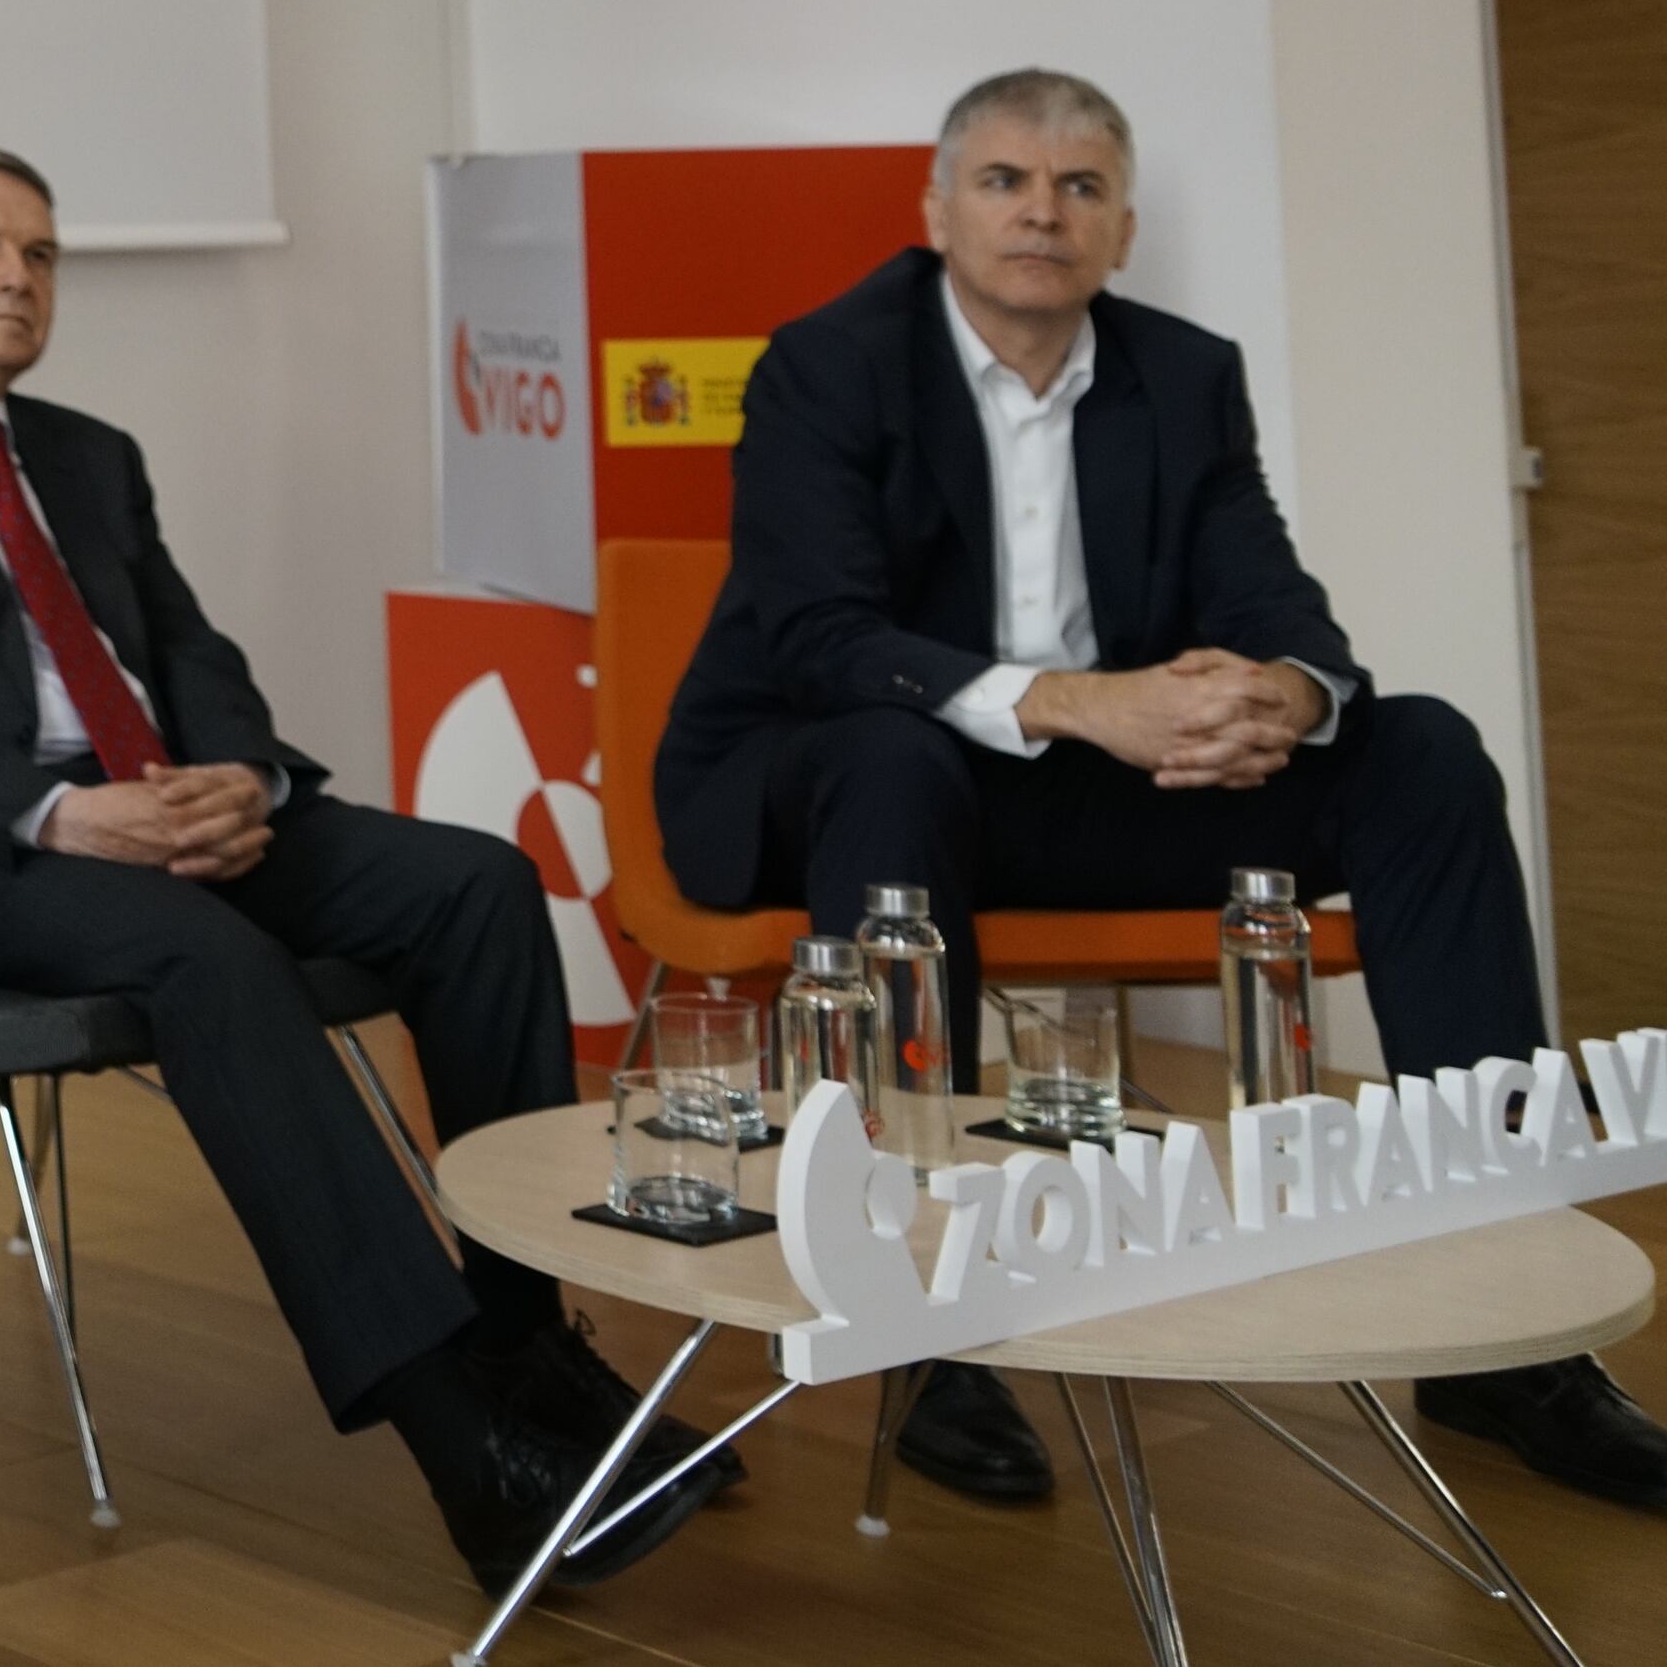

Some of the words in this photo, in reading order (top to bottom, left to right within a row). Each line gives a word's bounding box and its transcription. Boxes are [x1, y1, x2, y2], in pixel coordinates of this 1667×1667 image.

[479, 364, 565, 441] VIGO
[929, 1121, 1237, 1305] ZONA
[1230, 1047, 1597, 1231] FRANCA
